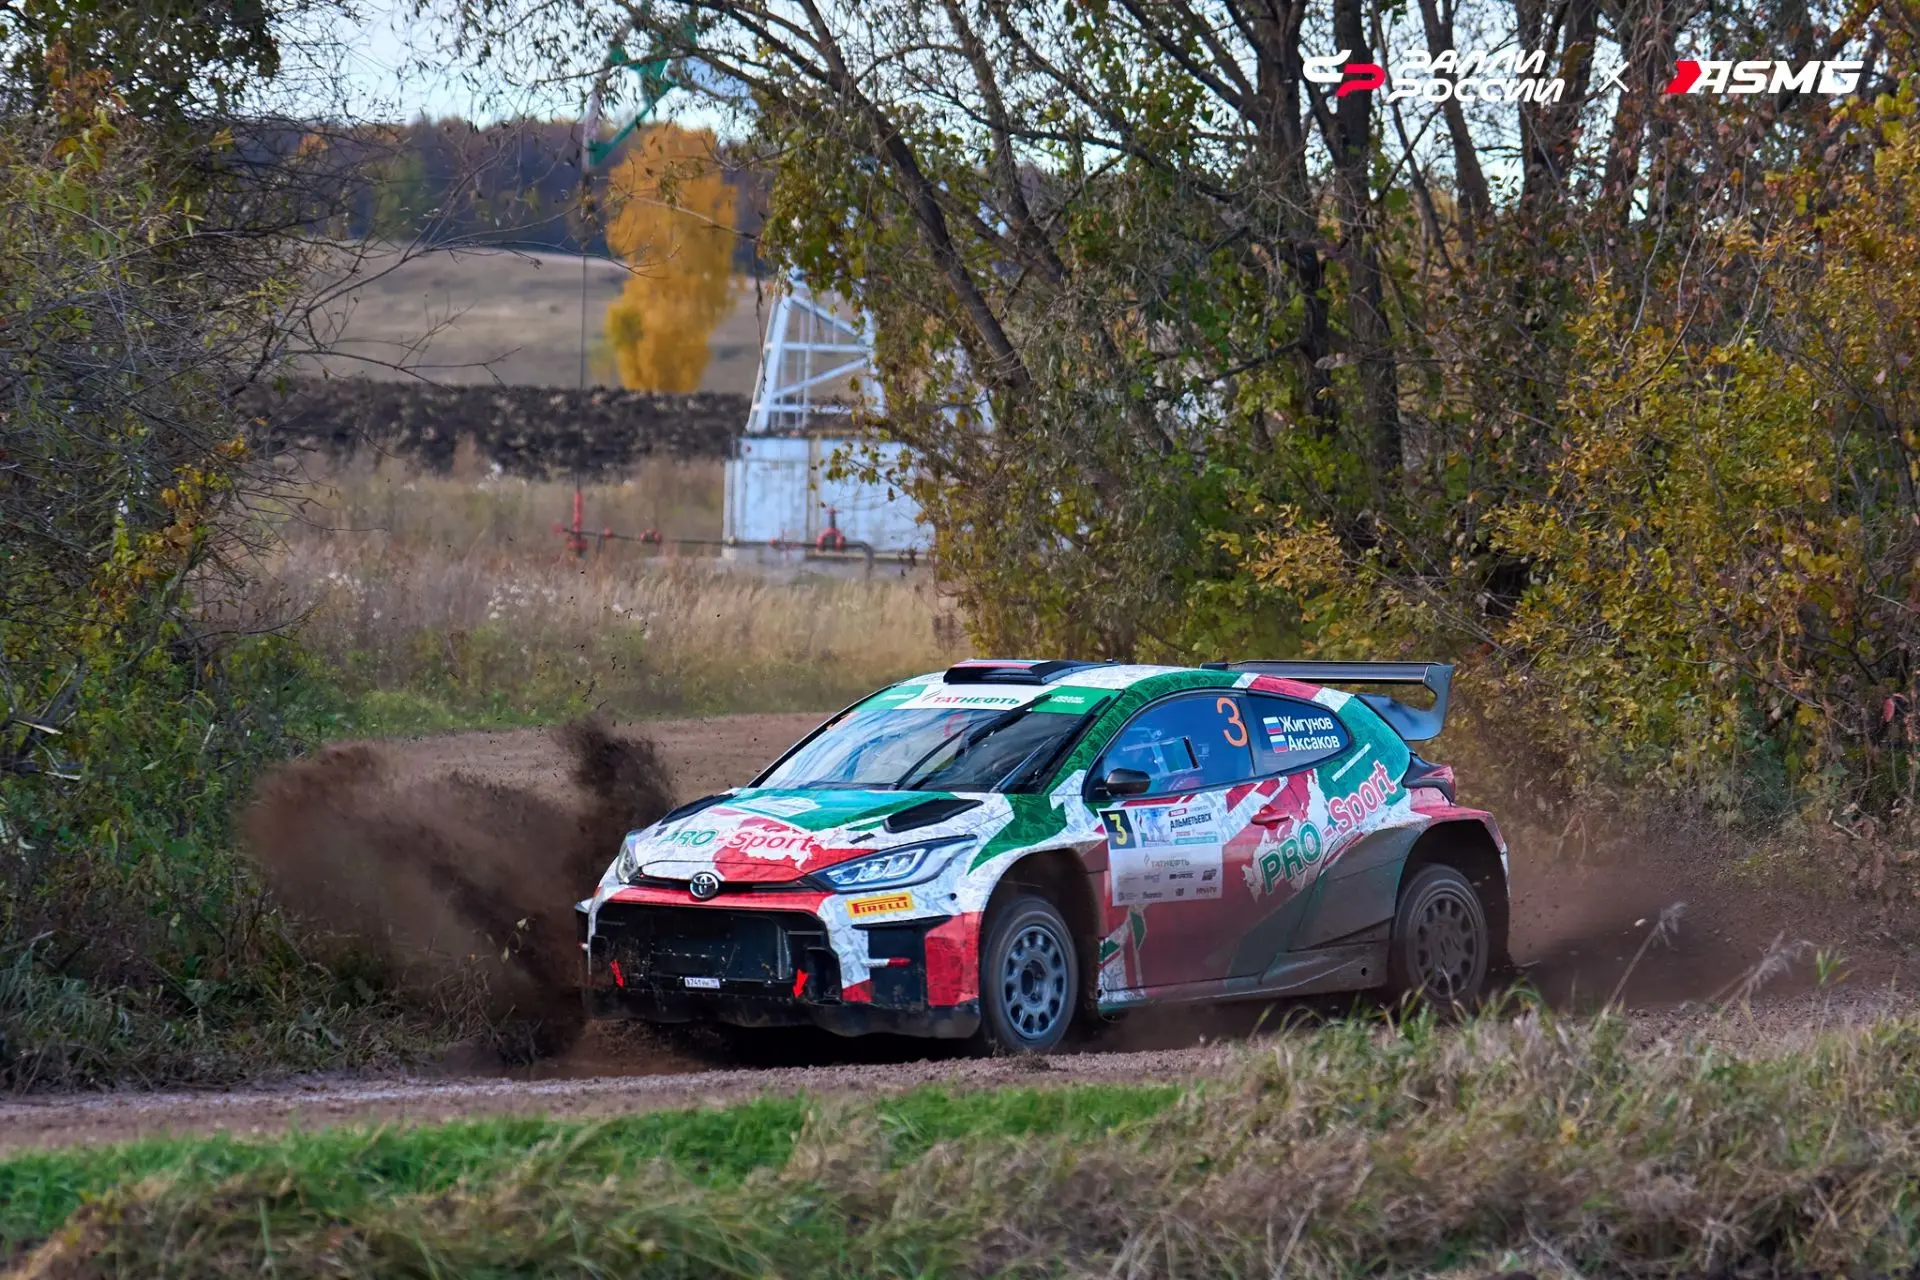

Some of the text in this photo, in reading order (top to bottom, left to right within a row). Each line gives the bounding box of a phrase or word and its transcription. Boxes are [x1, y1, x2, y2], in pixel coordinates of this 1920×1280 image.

[932, 696, 1021, 705] ТАТНЕФТЬ
[1216, 697, 1249, 747] 3
[1279, 716, 1334, 735] Жигунов
[1288, 735, 1340, 751] Аксаков
[1108, 813, 1128, 845] 3
[852, 896, 908, 914] PIRELLI
